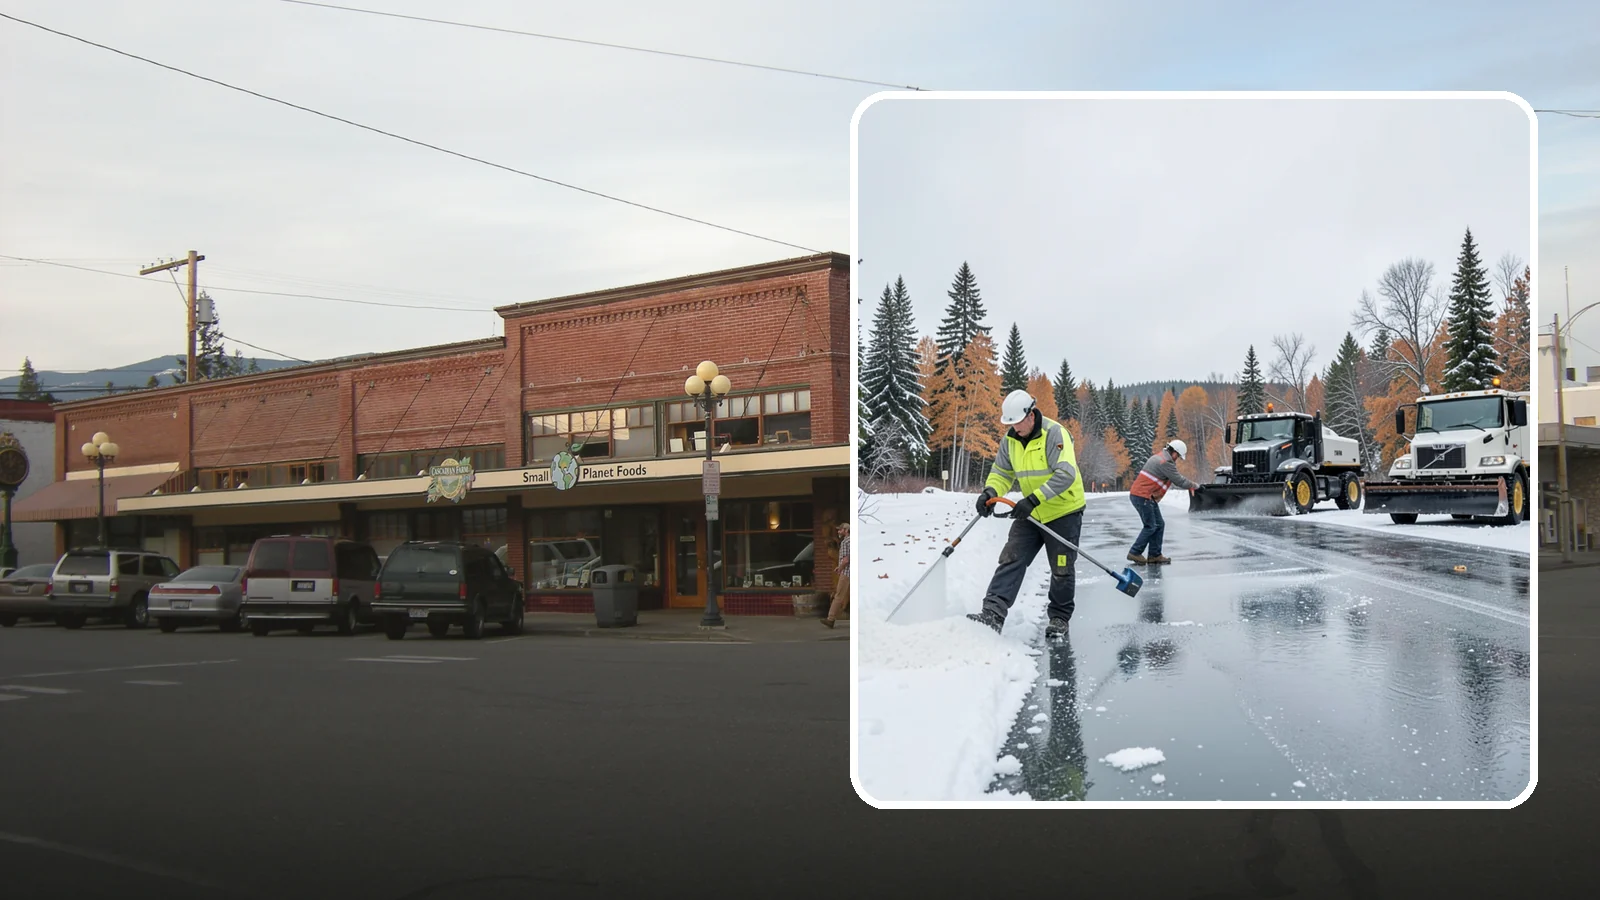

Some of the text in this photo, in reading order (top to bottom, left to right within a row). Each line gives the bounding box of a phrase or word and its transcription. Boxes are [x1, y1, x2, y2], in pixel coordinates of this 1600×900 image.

[523, 464, 647, 483] Small Planet Foods
